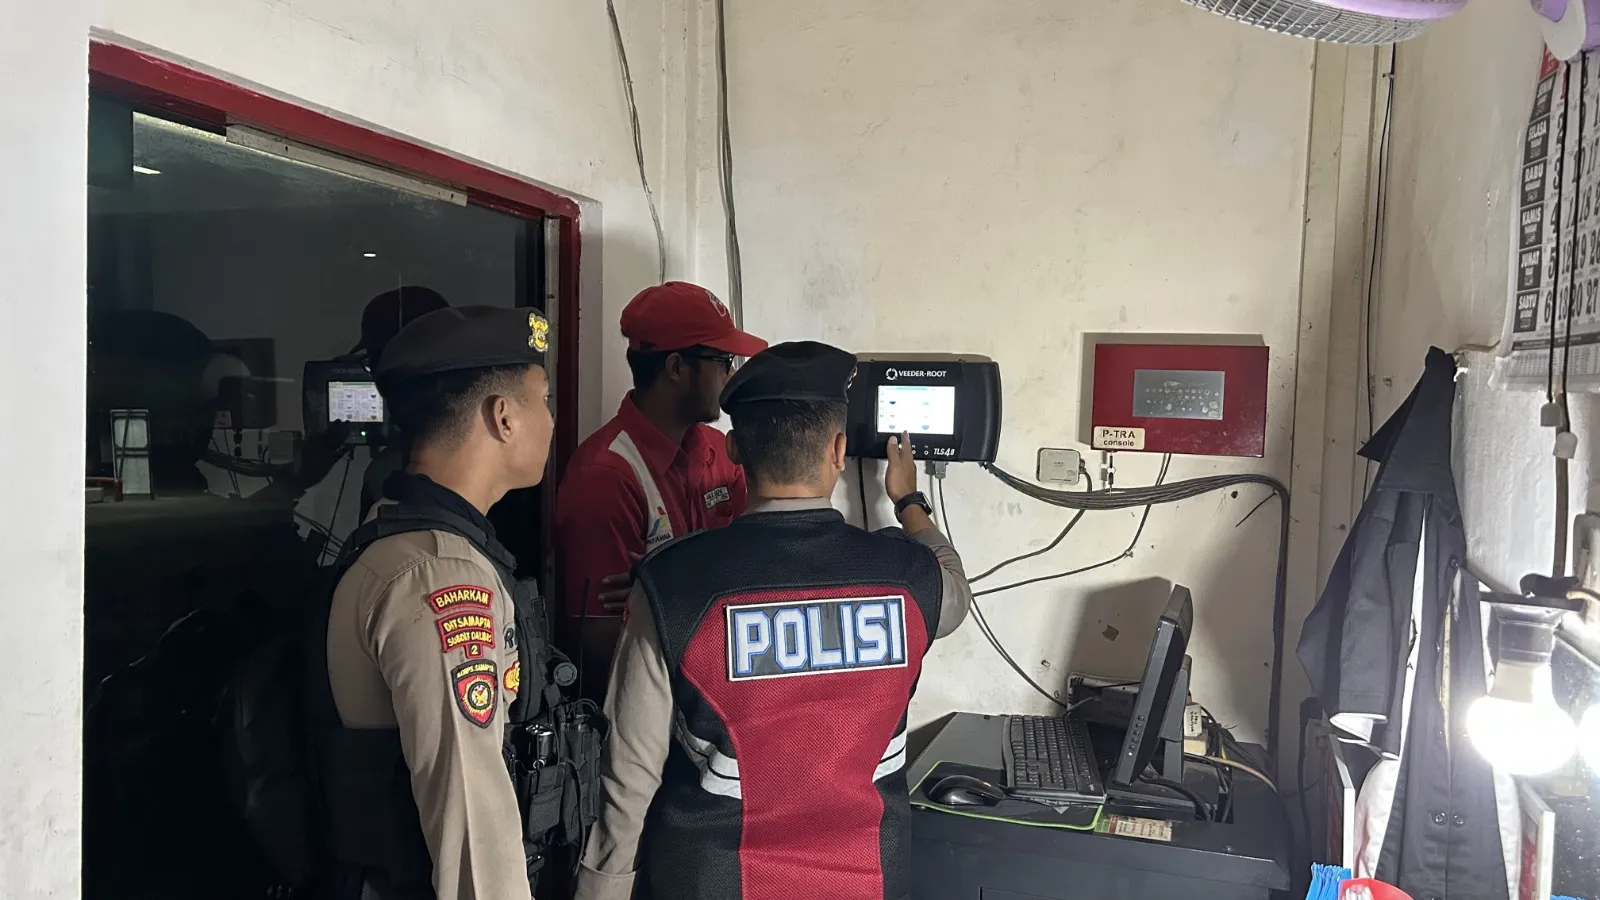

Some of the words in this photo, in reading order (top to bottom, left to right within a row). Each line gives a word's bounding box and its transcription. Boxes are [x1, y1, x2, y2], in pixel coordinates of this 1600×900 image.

[1529, 120, 1546, 140] SELASA
[1525, 162, 1543, 182] RABU
[1522, 207, 1541, 226] KAMIS
[1521, 250, 1539, 268] JUMAT
[1519, 293, 1537, 310] SABTU
[1585, 277, 1599, 316] 27
[1544, 290, 1553, 324] 6
[898, 370, 947, 378] VEEDER-ROOT
[1102, 429, 1136, 439] P-TRA
[1103, 439, 1135, 447] console
[436, 590, 488, 607] BAHARKAM
[734, 602, 903, 674] POLISI
[471, 645, 478, 654] 2
